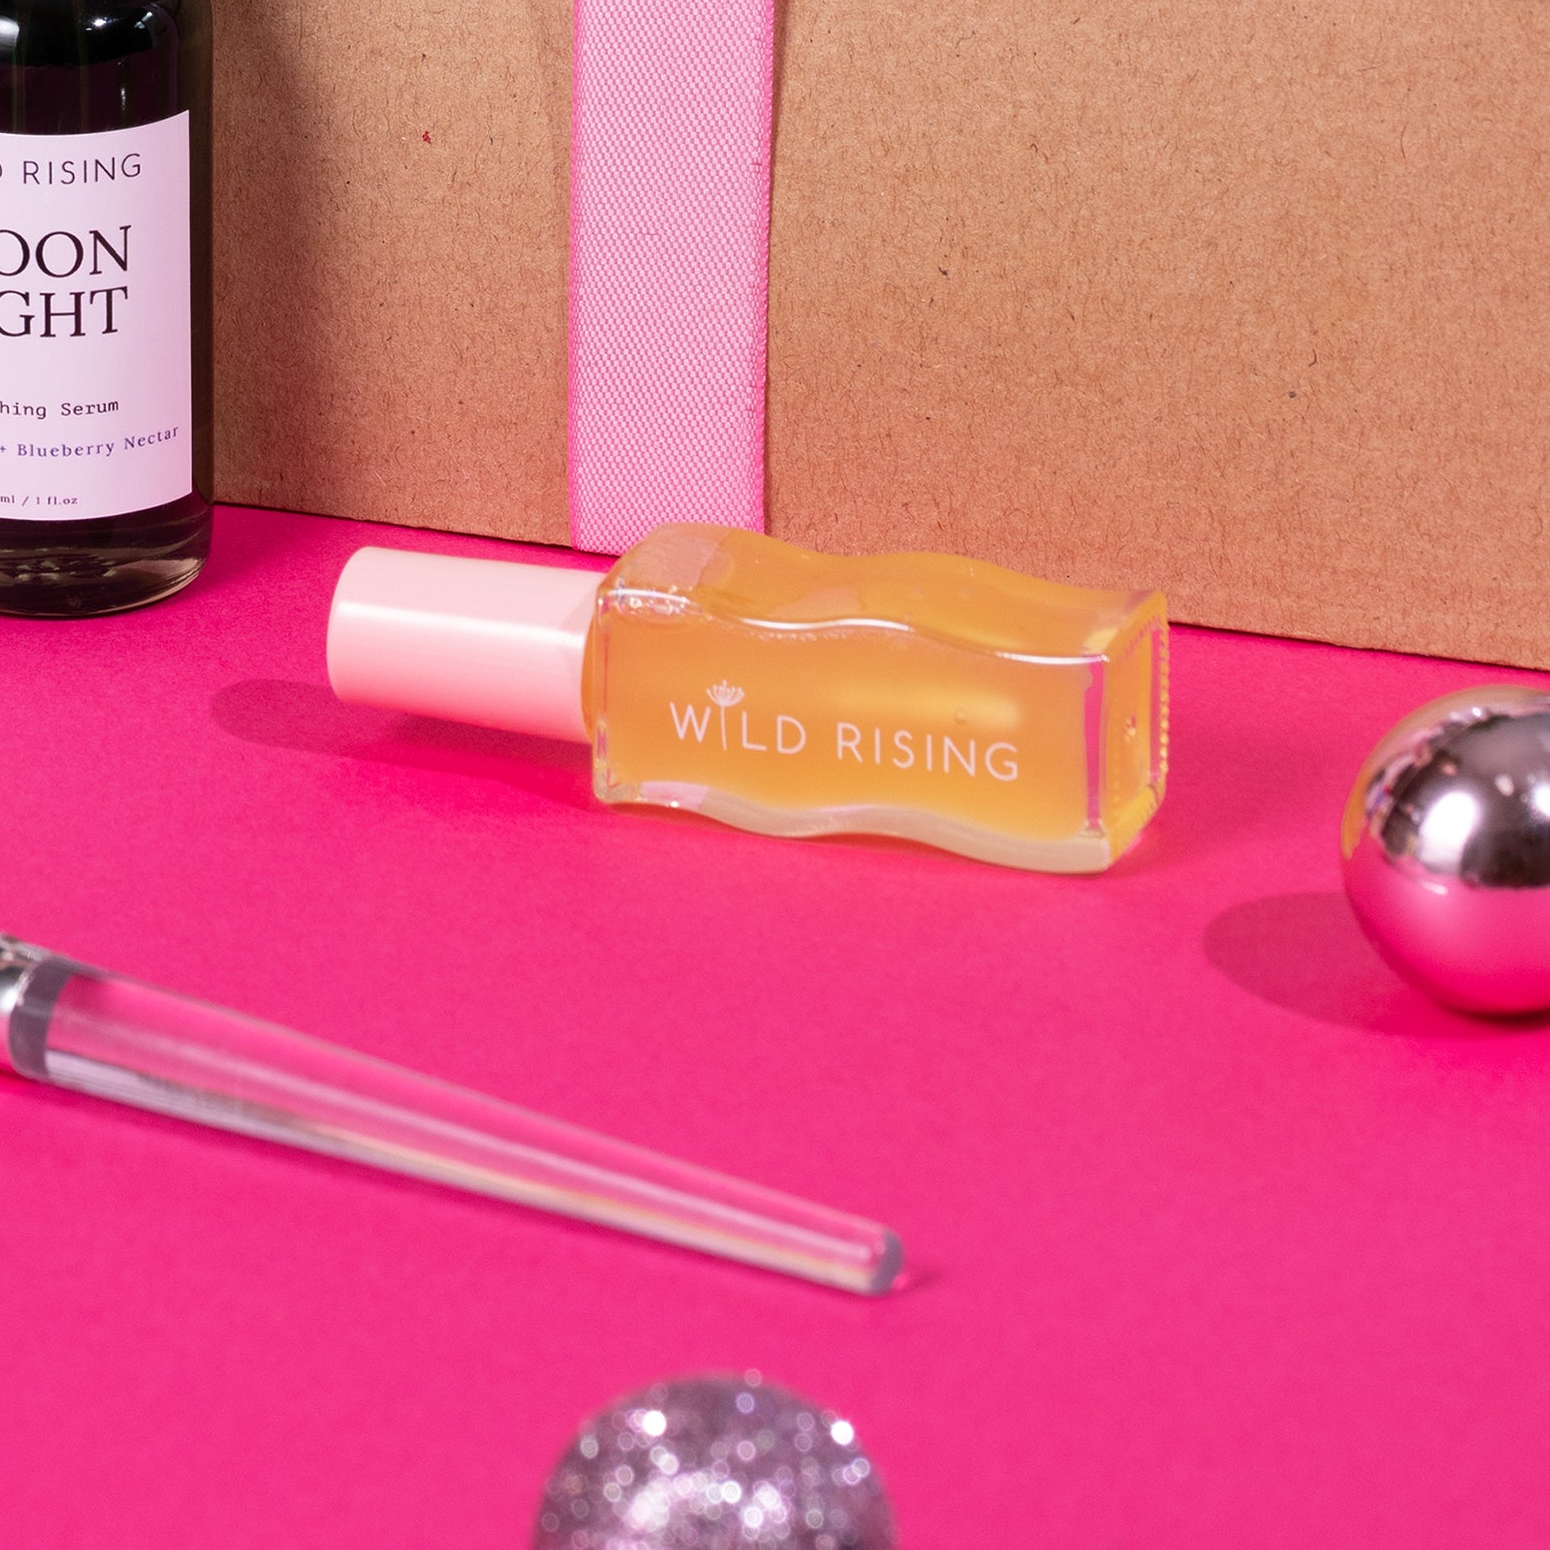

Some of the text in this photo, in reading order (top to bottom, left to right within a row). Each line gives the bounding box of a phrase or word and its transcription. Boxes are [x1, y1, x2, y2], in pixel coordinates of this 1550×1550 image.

[23, 152, 142, 186] RISING
[60, 398, 120, 418] Serum
[17, 439, 116, 459] Blueberry
[123, 424, 180, 452] Nectar
[21, 495, 30, 507] /
[668, 679, 1020, 782] WILD RISING
